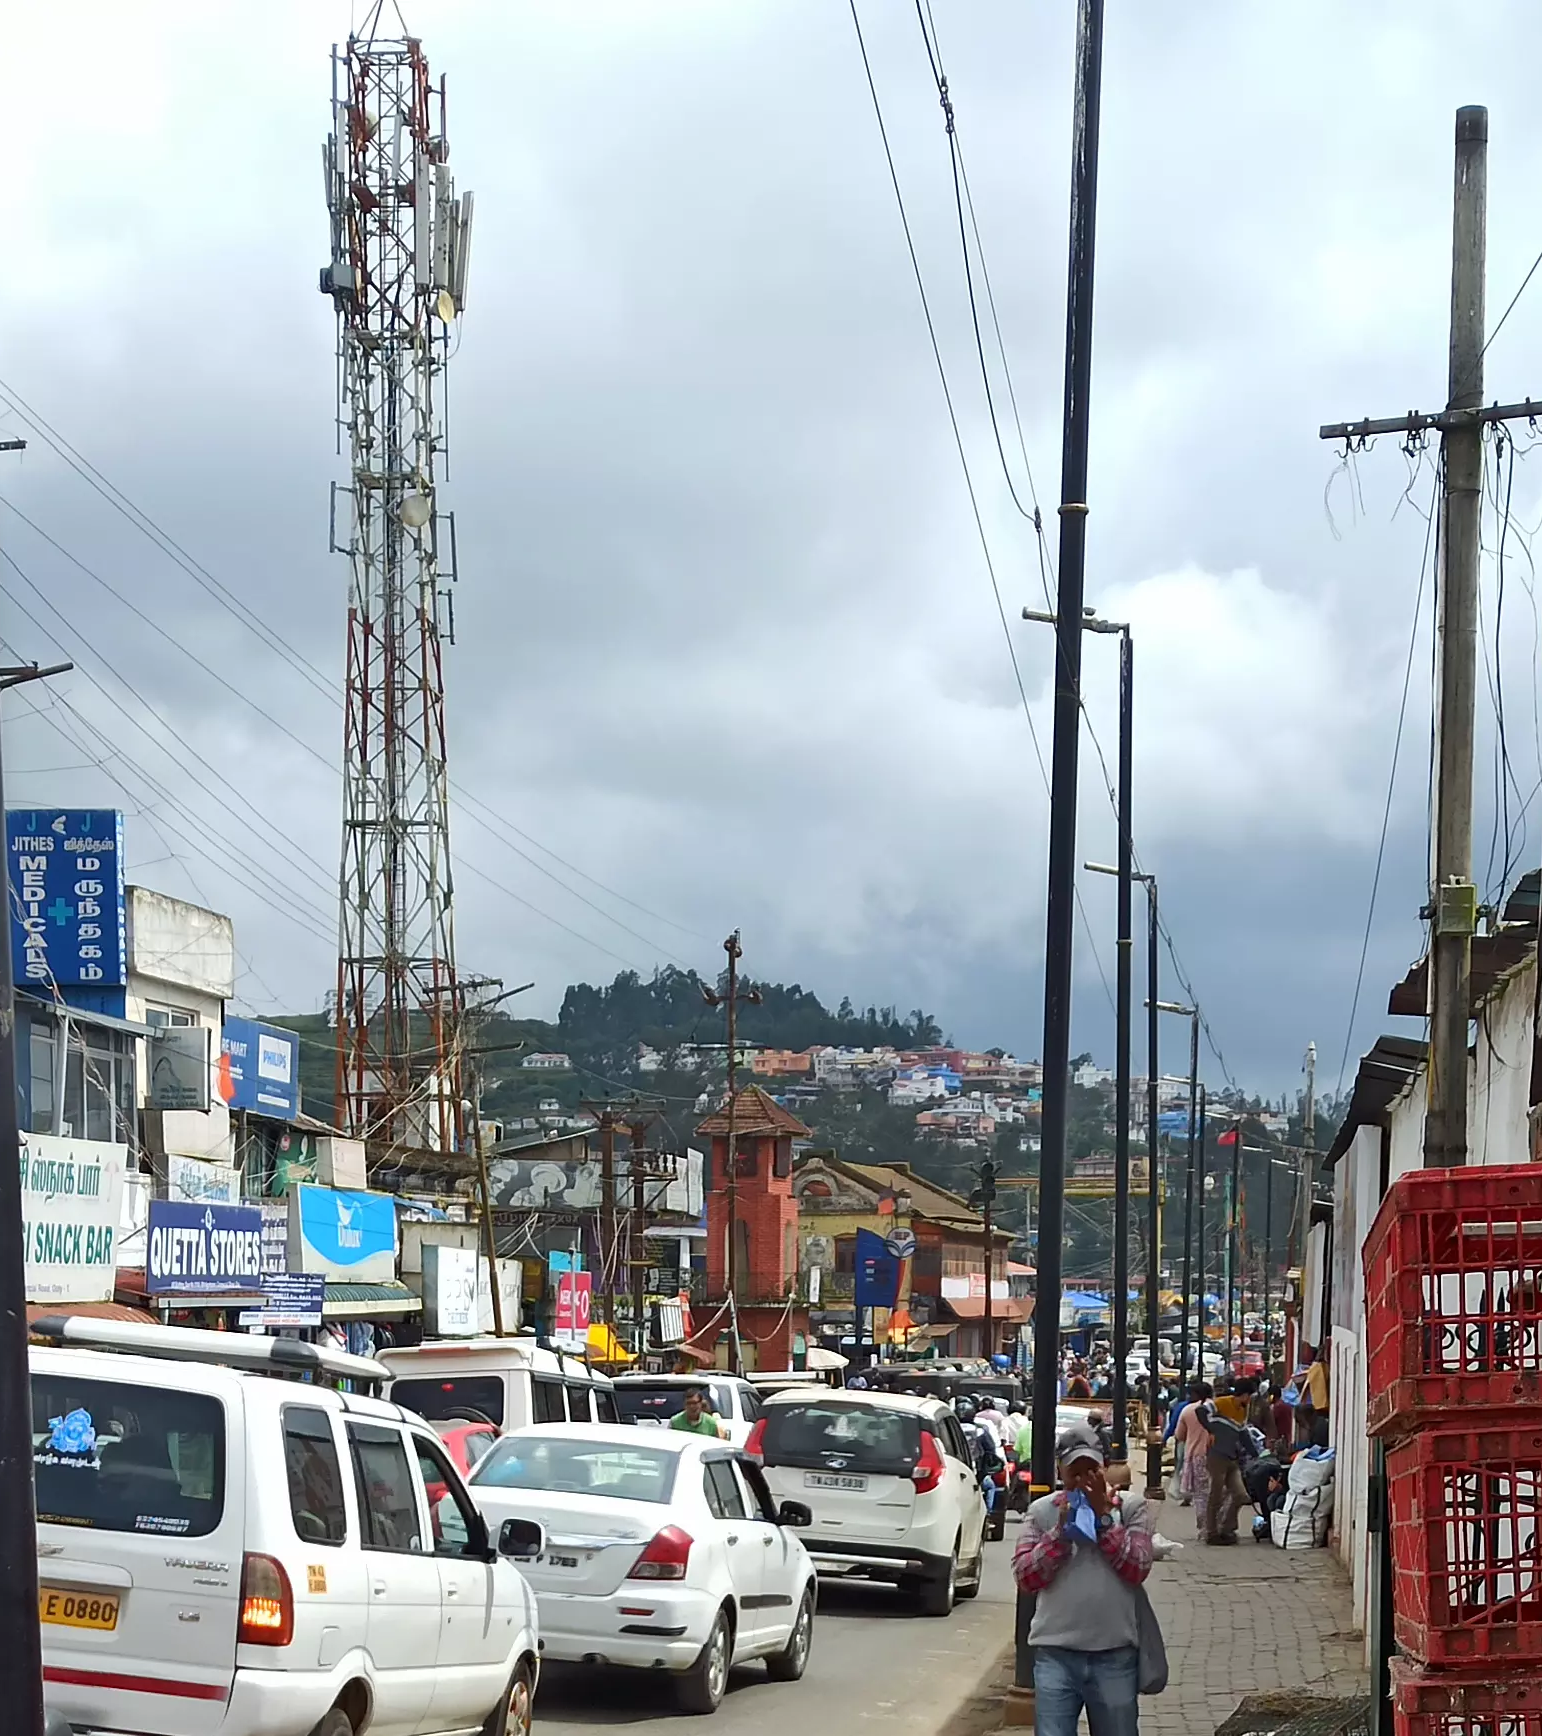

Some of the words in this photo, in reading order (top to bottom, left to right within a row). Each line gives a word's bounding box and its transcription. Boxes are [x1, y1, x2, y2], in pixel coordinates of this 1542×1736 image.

[11, 836, 55, 852] JITHES
[19, 855, 48, 979] MEDICALS
[74, 857, 104, 981] மருந்தகம்
[34, 1222, 84, 1264] SNACK
[85, 1225, 114, 1265] BAR
[150, 1226, 208, 1279] QUETTA
[209, 1229, 261, 1277] STORES
[46, 1594, 58, 1616] E
[63, 1594, 117, 1621] 0880
